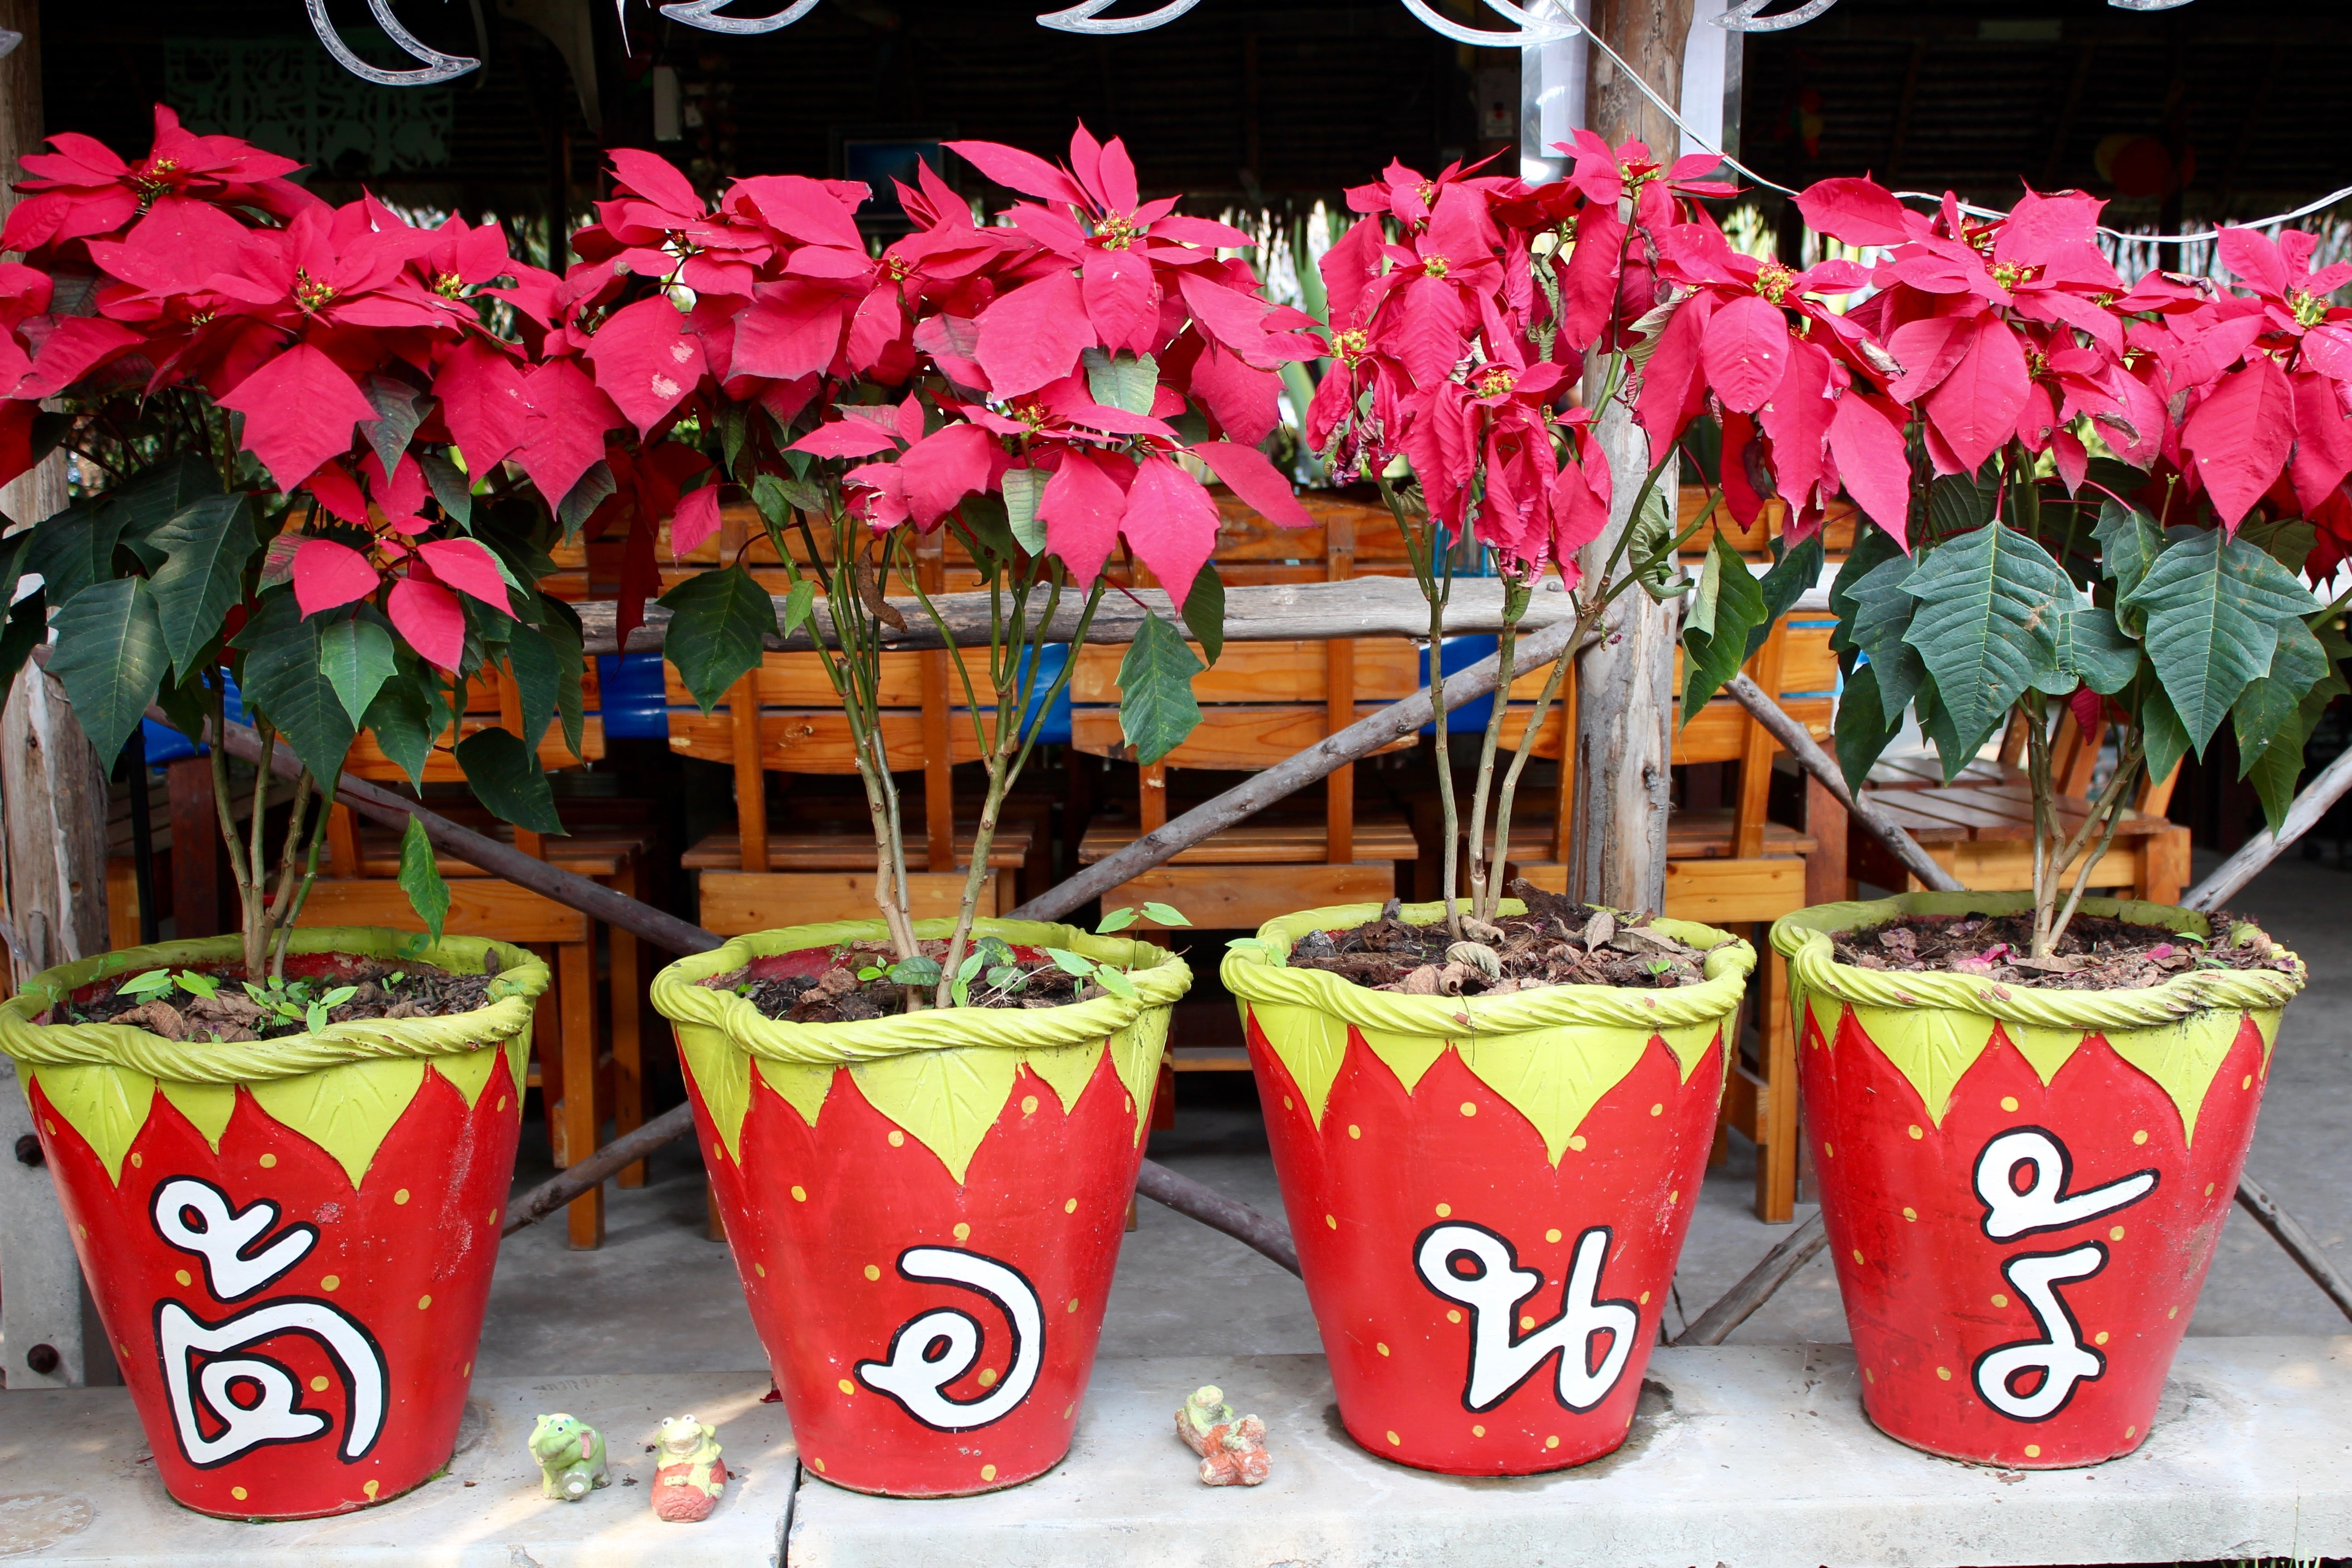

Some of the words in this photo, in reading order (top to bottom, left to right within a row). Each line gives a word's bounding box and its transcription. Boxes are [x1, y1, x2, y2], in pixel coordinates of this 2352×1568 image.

[151, 1177, 388, 1467] ต้
[857, 1246, 1045, 1432] อ
[1416, 1222, 1639, 1412] น
[1973, 1127, 2159, 1421] รั
